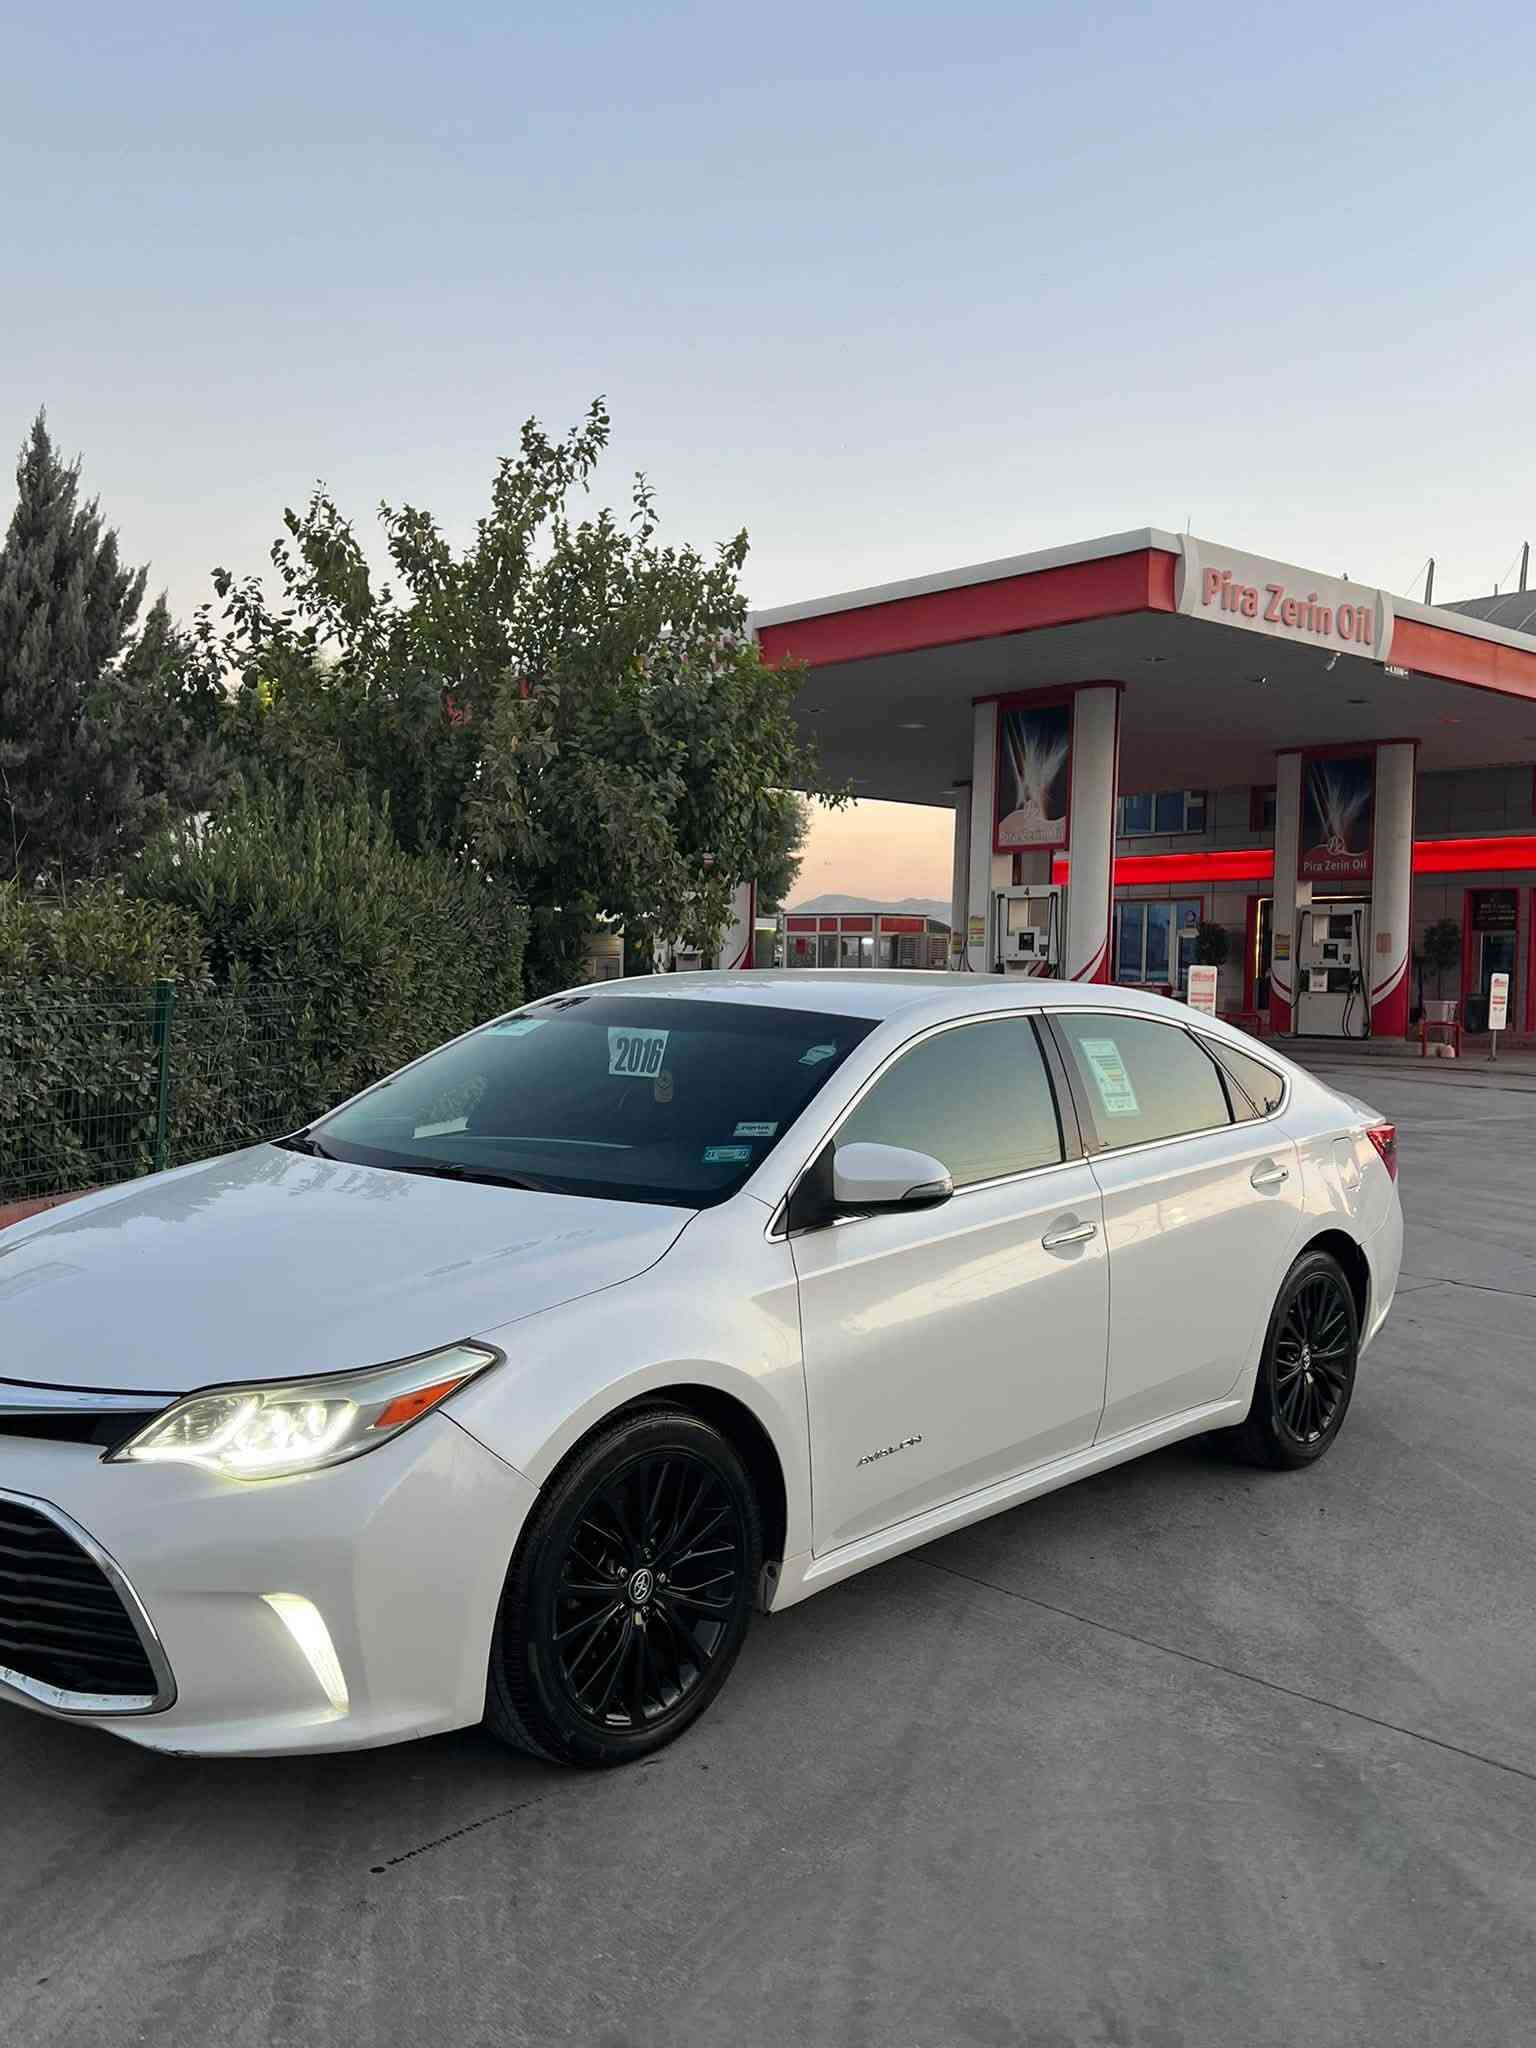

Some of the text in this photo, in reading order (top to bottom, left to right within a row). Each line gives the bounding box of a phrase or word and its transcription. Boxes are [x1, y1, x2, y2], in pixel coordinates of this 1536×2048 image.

[1202, 567, 1373, 646] Pira Zerin Oil
[1303, 861, 1323, 873] Pira
[1352, 858, 1368, 871] Oil
[614, 1037, 666, 1074] 2016
